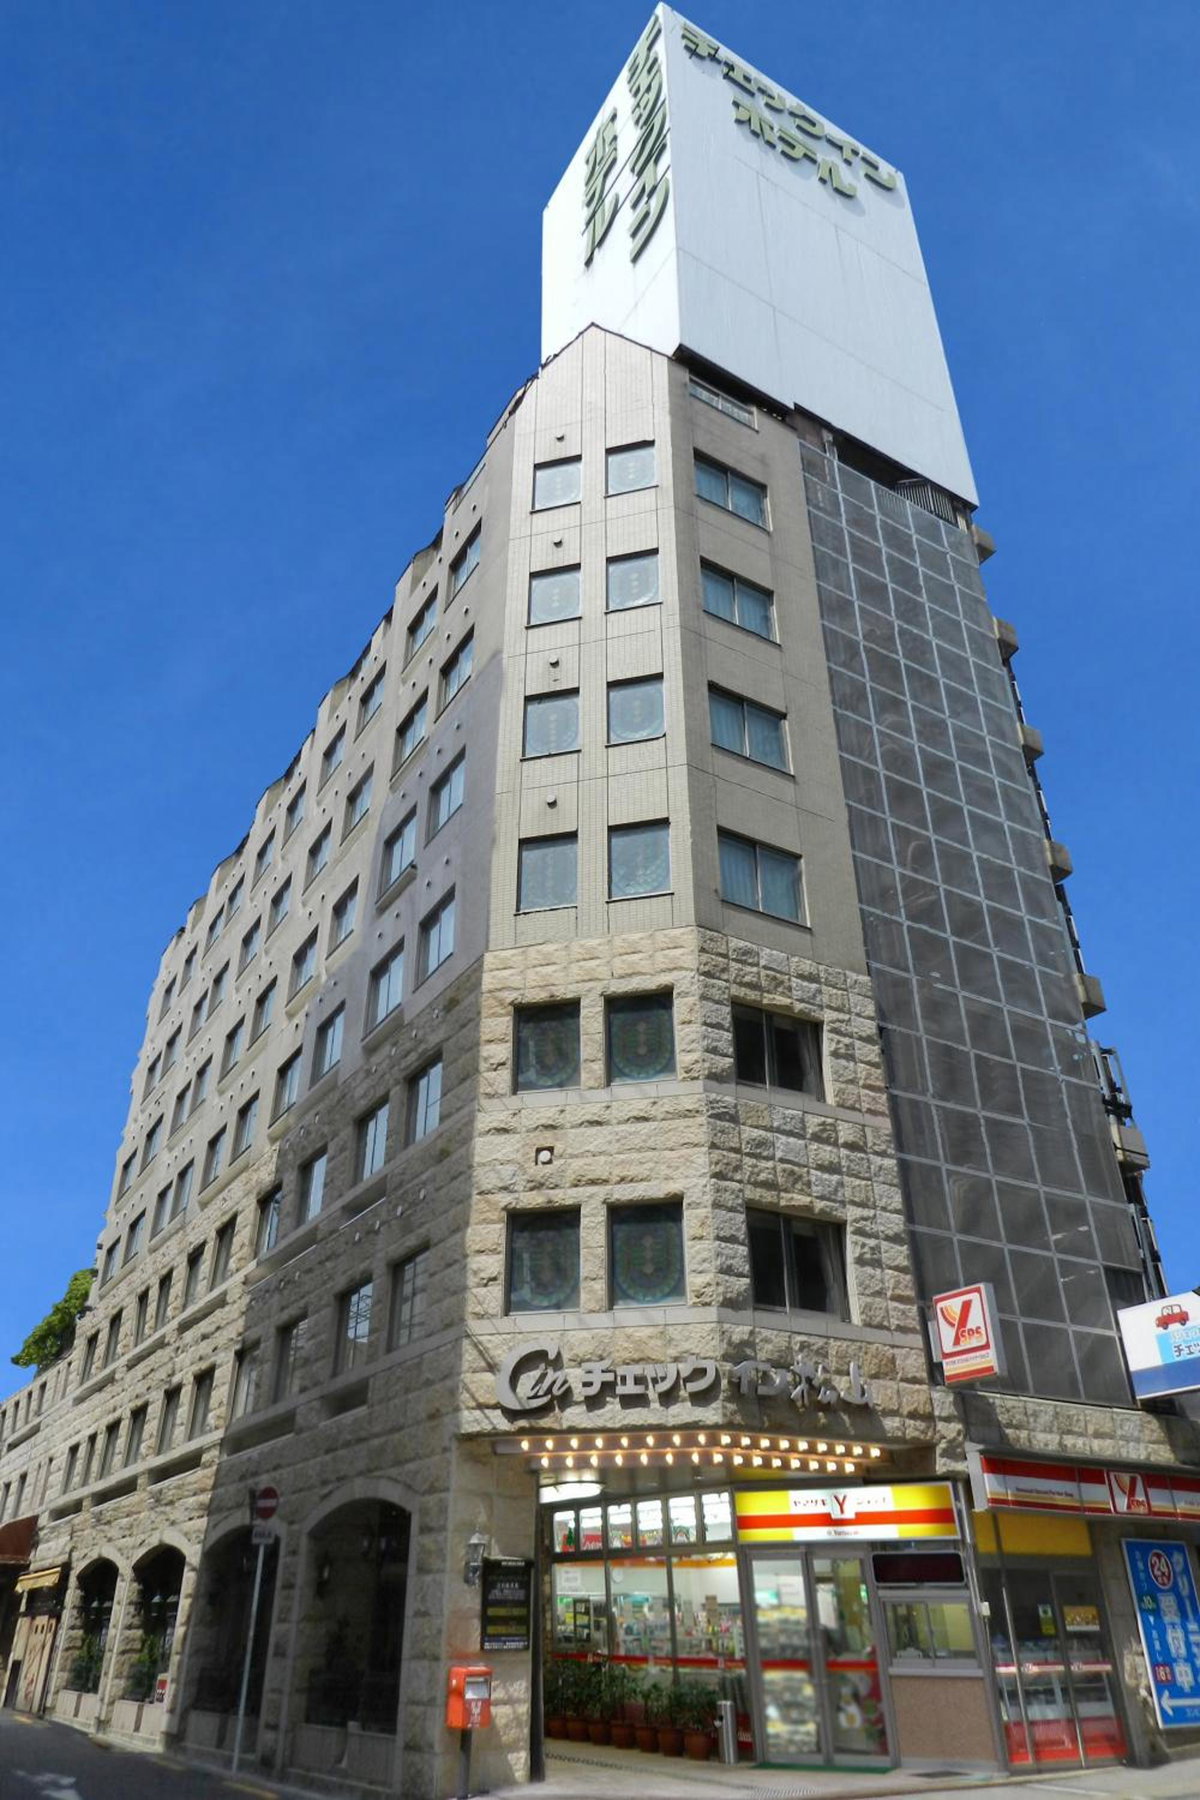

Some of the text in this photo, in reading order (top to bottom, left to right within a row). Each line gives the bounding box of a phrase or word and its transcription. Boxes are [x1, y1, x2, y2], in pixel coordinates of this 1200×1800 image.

[681, 22, 898, 191] チェックイン
[731, 96, 858, 199] ホテル
